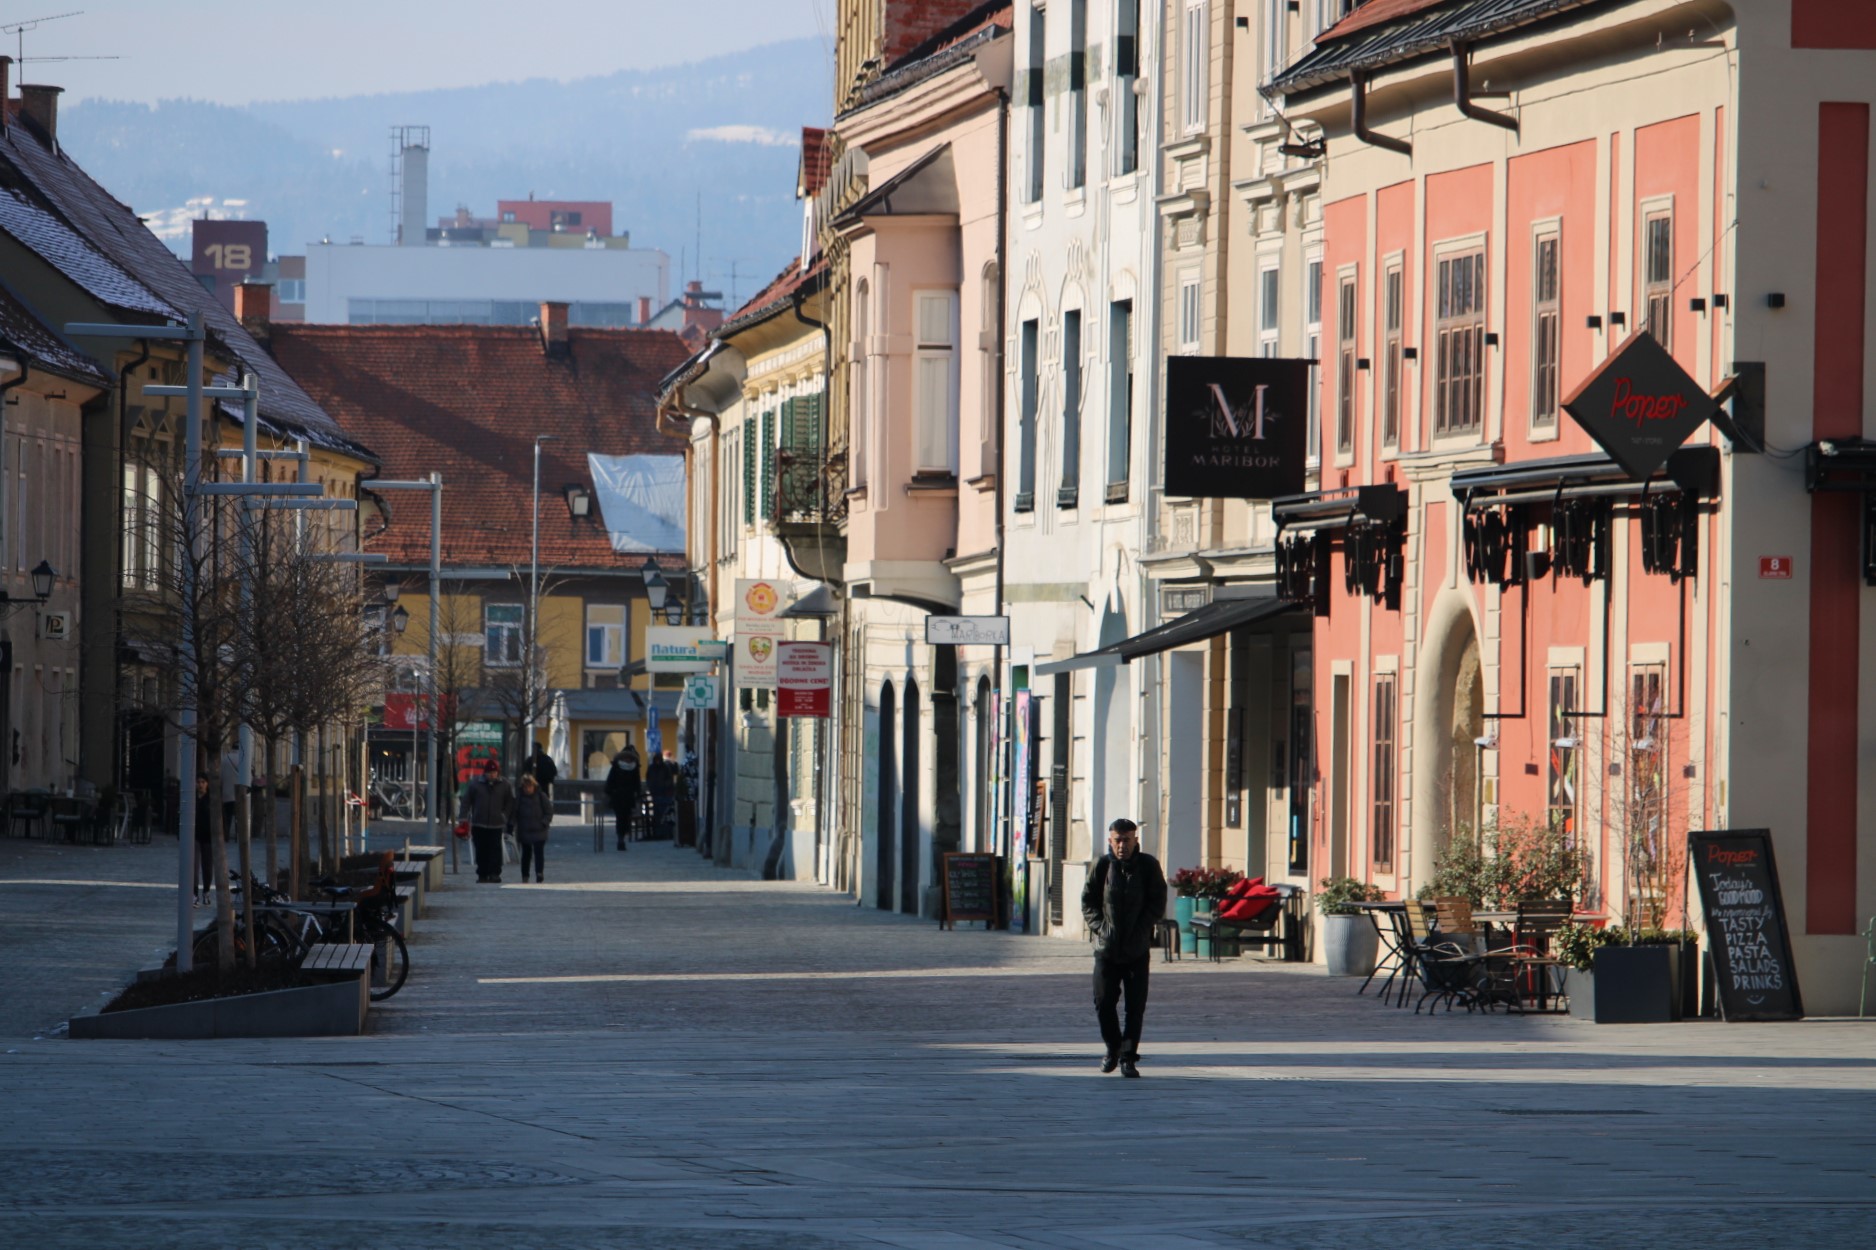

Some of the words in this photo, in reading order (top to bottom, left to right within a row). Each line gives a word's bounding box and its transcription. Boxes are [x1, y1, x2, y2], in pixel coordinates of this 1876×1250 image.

[203, 243, 252, 270] 18
[1610, 376, 1689, 429] Poper
[1211, 445, 1260, 455] HOTEL
[1191, 454, 1281, 468] MARIBOR
[1770, 558, 1780, 571] 8
[1707, 844, 1758, 867] Poper
[1718, 916, 1765, 932] TASTY
[1725, 932, 1768, 946] PIZZA
[1728, 945, 1772, 960] PASTA
[1730, 959, 1780, 974] SALADS
[1733, 974, 1783, 990] DRINKS
